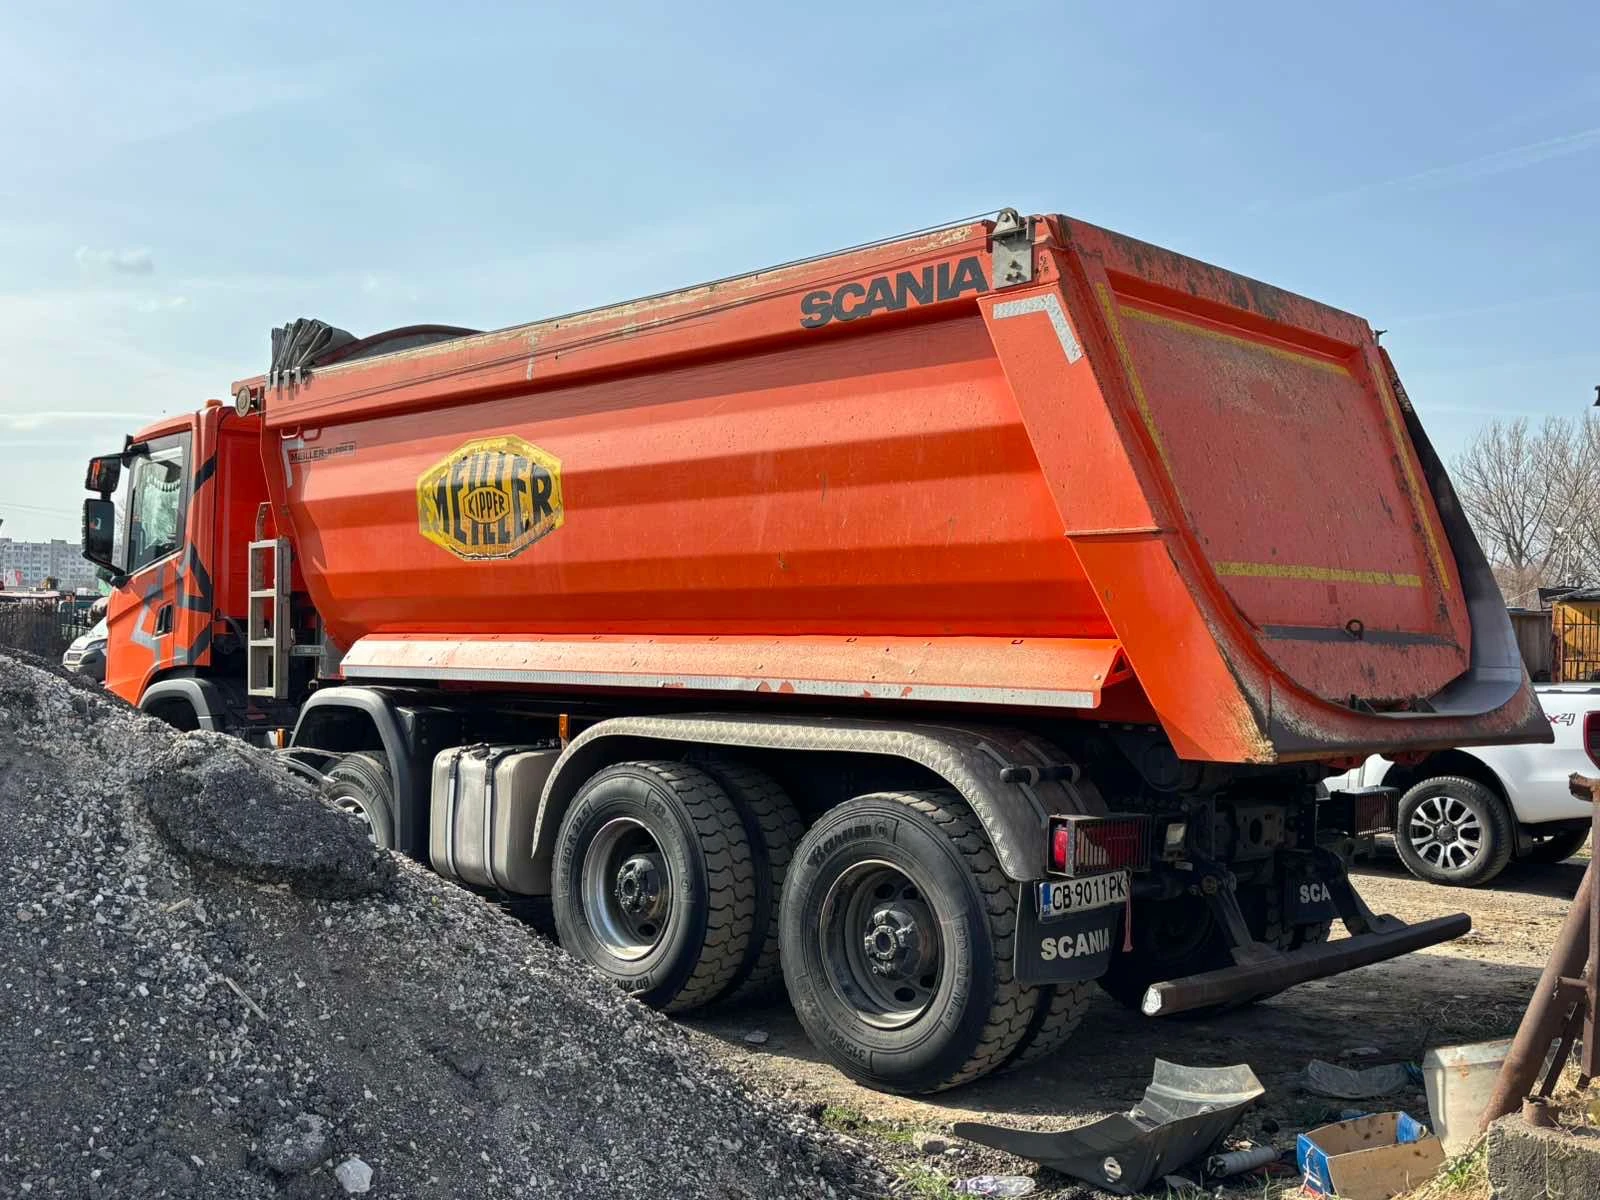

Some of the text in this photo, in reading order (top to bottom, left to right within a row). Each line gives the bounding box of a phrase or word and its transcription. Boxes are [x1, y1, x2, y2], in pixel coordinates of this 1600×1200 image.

[800, 256, 990, 329] SCANIA
[431, 451, 554, 547] MEILLER
[467, 491, 505, 519] KIPPER
[1545, 712, 1576, 727] x4
[1040, 927, 1110, 961] SCANIA
